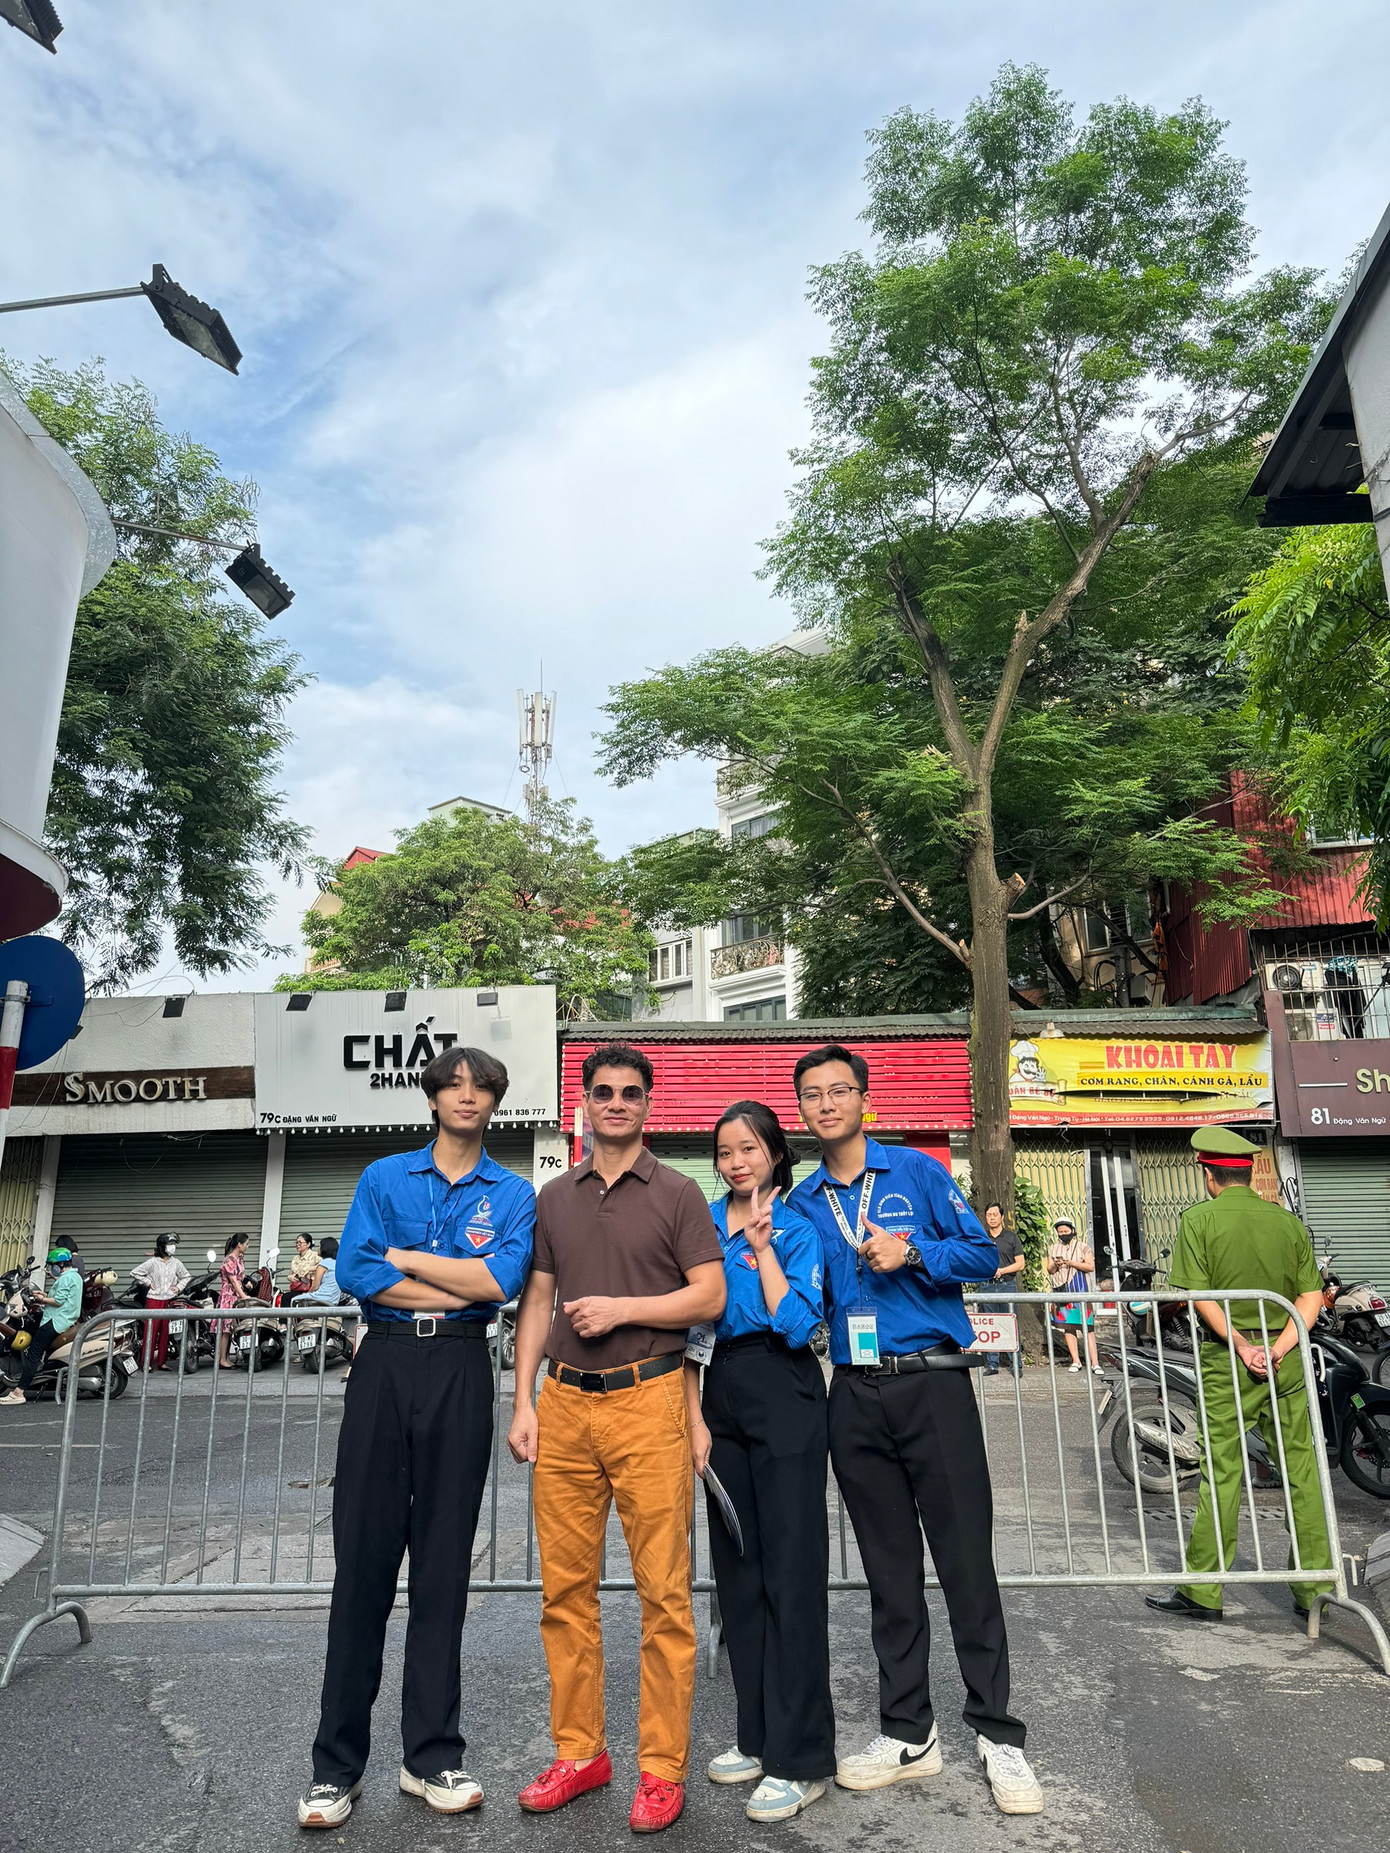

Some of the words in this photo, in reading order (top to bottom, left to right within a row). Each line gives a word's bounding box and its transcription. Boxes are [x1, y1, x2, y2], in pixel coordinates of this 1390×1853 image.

[343, 1016, 458, 1068] CHẤT
[1105, 1044, 1184, 1069] KHOAI
[1188, 1038, 1236, 1069] TÂY
[370, 1072, 423, 1087] 2HAN
[1080, 1076, 1104, 1086] CƠM
[1107, 1077, 1142, 1087] RANG,
[1145, 1075, 1180, 1087] CHÂN,
[1183, 1075, 1214, 1086] CÁNH
[1217, 1075, 1237, 1087] GÀ,
[64, 1072, 208, 1103] SMOOTH
[1008, 1086, 1026, 1096] UÁN
[282, 1115, 302, 1125] ĐẶNG
[305, 1114, 319, 1123] VĂN
[532, 1108, 546, 1116] 777
[1311, 1107, 1330, 1125] 81
[861, 1169, 876, 1210] OFF-WHIT
[974, 1331, 1001, 1343] OP
